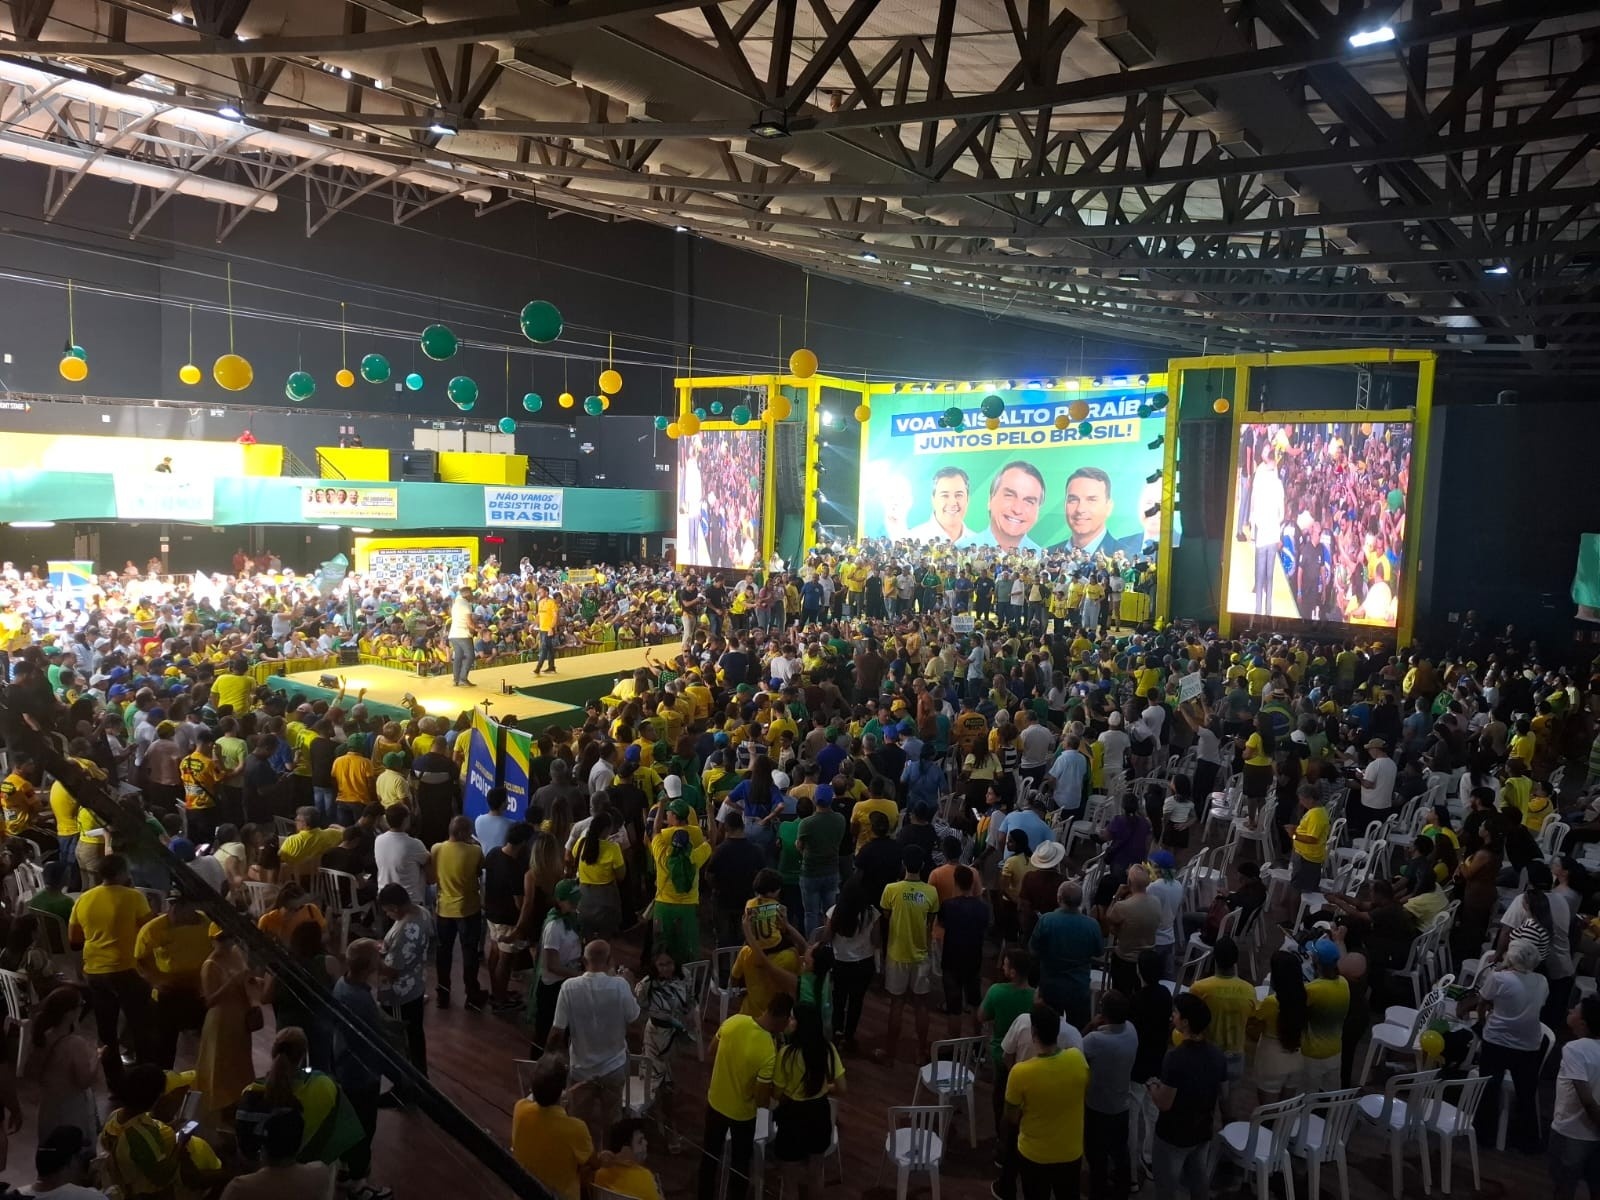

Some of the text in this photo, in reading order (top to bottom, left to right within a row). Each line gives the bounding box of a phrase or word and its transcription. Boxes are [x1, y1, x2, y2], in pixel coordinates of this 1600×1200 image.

[896, 416, 937, 433] VOA
[939, 411, 988, 429] AIS
[998, 408, 1050, 425] ALTO
[920, 424, 1132, 449] JUNTOS PELO BRSIL!
[521, 494, 554, 502] VAMOS
[489, 501, 559, 511] DESISTIR DO
[491, 511, 560, 521] BRASIL!
